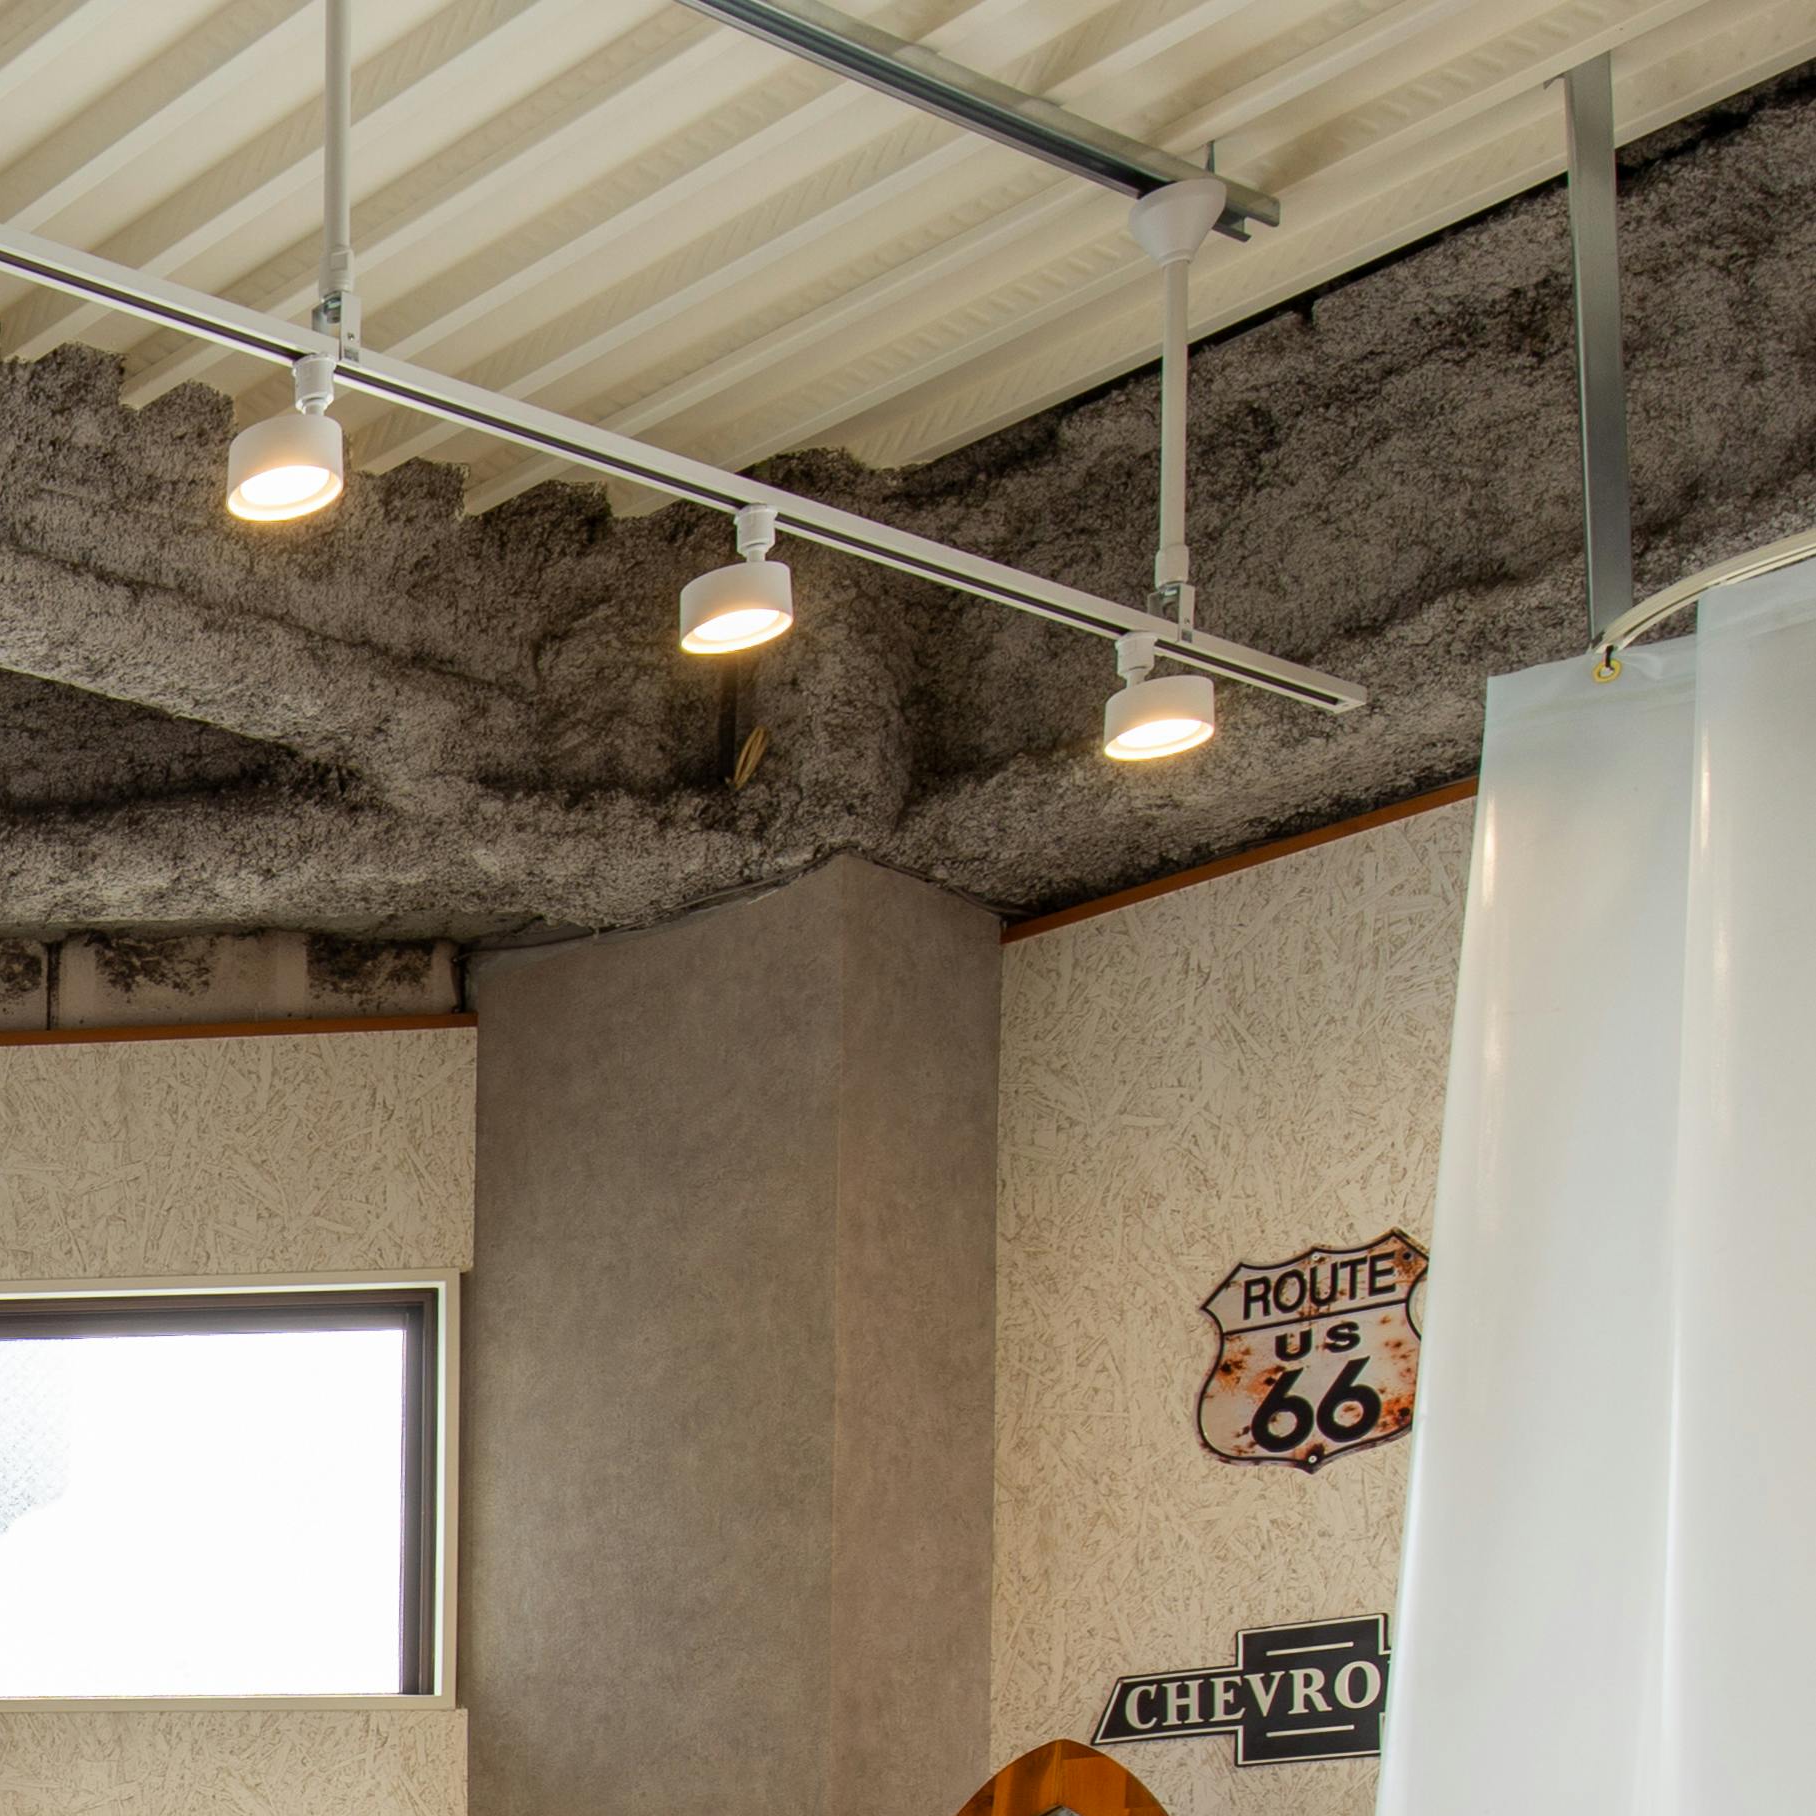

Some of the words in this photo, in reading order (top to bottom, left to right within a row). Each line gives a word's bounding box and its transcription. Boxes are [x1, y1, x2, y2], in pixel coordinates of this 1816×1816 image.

[1243, 1251, 1396, 1320] ROUTE
[1251, 1356, 1382, 1453] 66
[1125, 1660, 1390, 1730] CHEVRO
